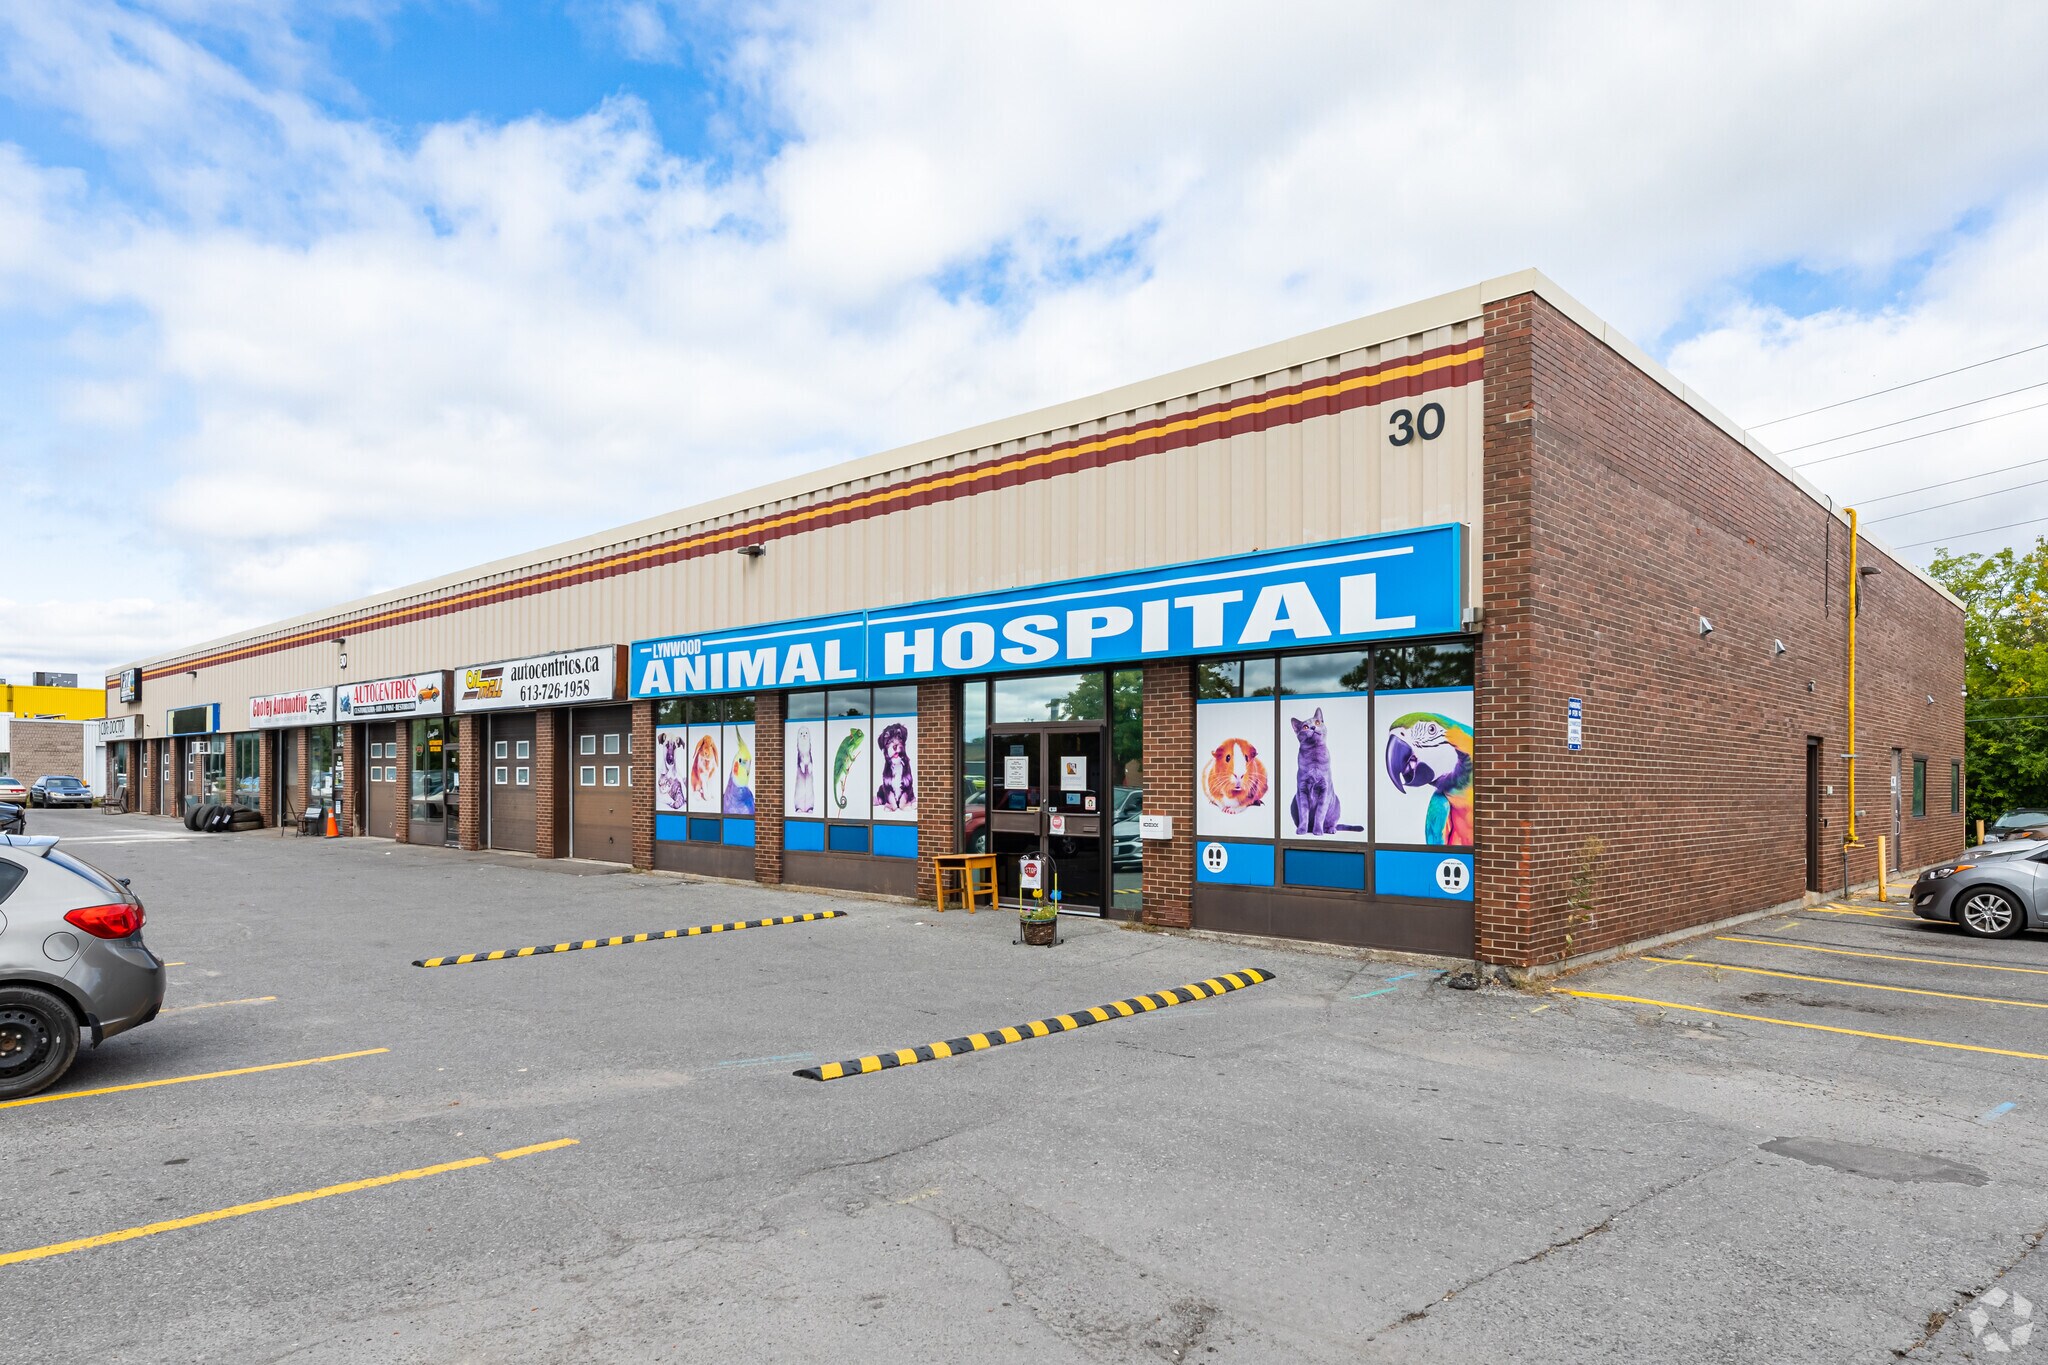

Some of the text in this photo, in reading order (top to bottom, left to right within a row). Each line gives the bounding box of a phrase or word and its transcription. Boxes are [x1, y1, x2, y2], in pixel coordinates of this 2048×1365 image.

[1389, 402, 1445, 447] 30
[639, 572, 1416, 694] ANIMAL HOSPITAL
[652, 639, 701, 659] LYNWOOD
[510, 655, 600, 682] autocentrics.ca
[353, 678, 417, 704] AUTOCENTRICS
[520, 679, 590, 701] 613-726-1958
[253, 694, 307, 717] Cooley Automotive
[1025, 866, 1037, 874] STOP
